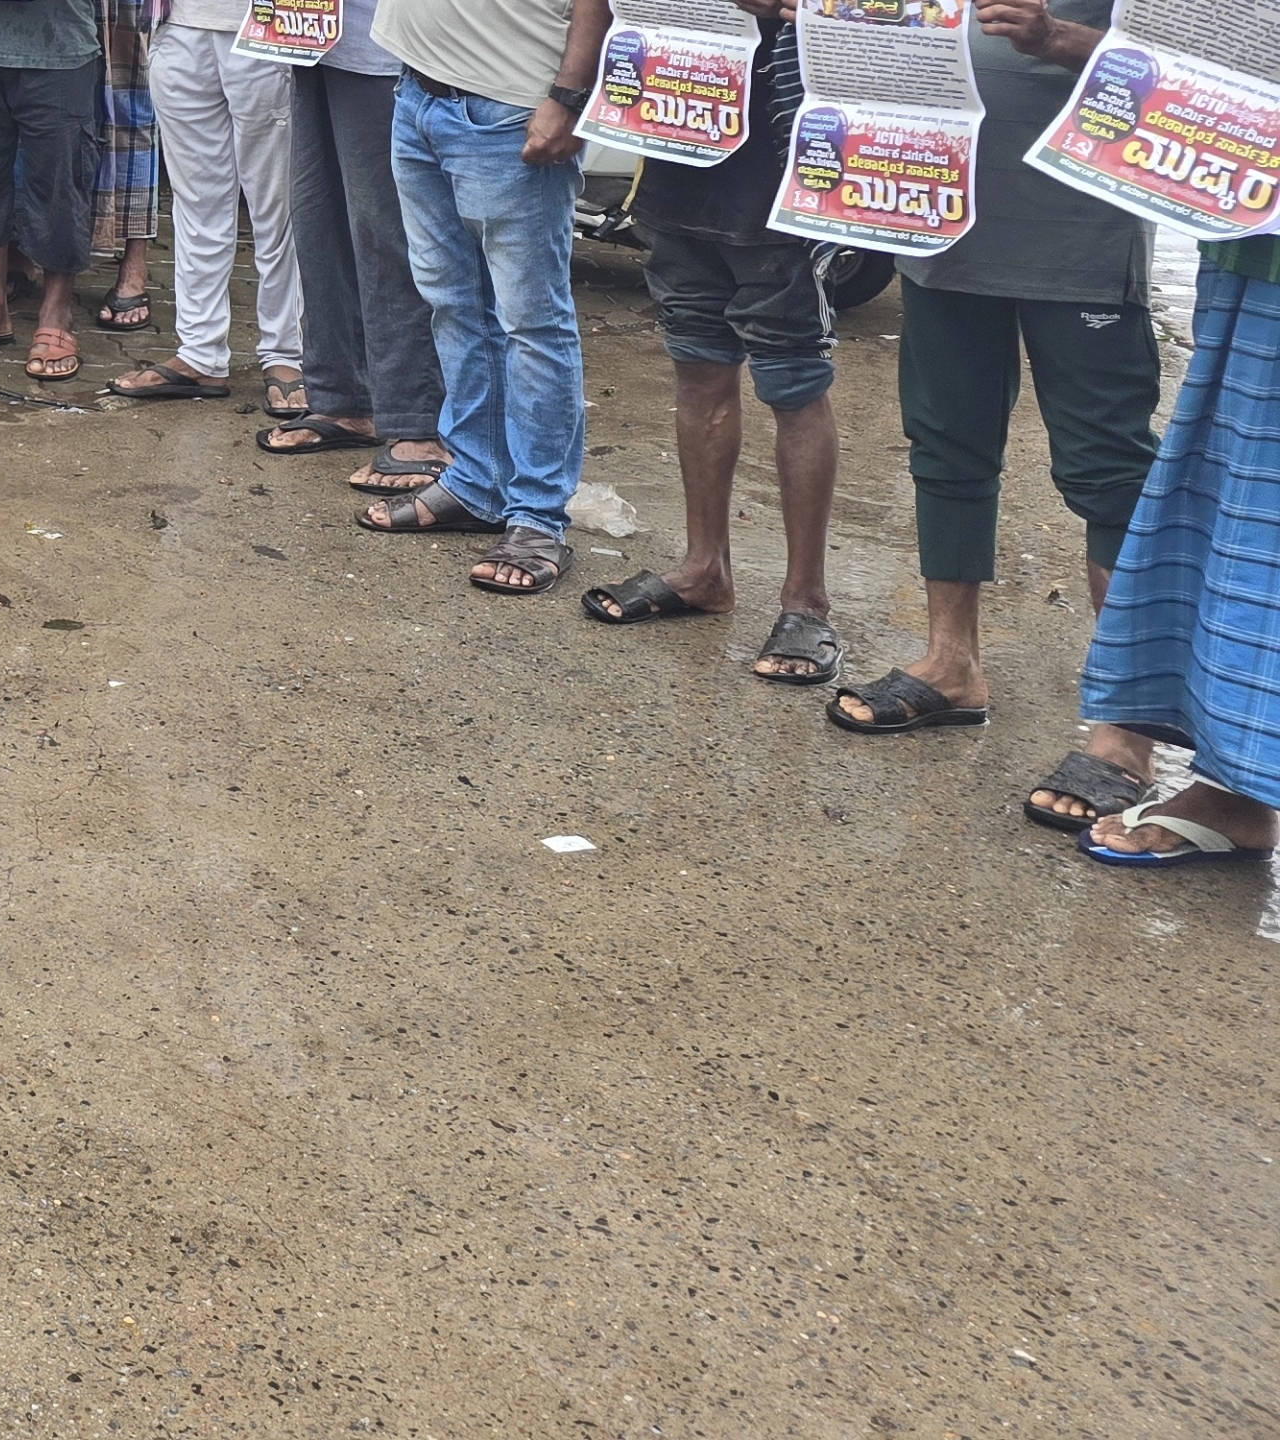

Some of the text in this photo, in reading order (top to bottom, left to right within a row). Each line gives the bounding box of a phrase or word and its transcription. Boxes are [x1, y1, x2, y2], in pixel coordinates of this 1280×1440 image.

[1188, 92, 1228, 114] JCTU
[1122, 127, 1279, 210] ಮುಷ್ಕರ
[841, 172, 964, 228] ಮುಷ್ಕರ
[1080, 312, 1121, 320] Reebok
